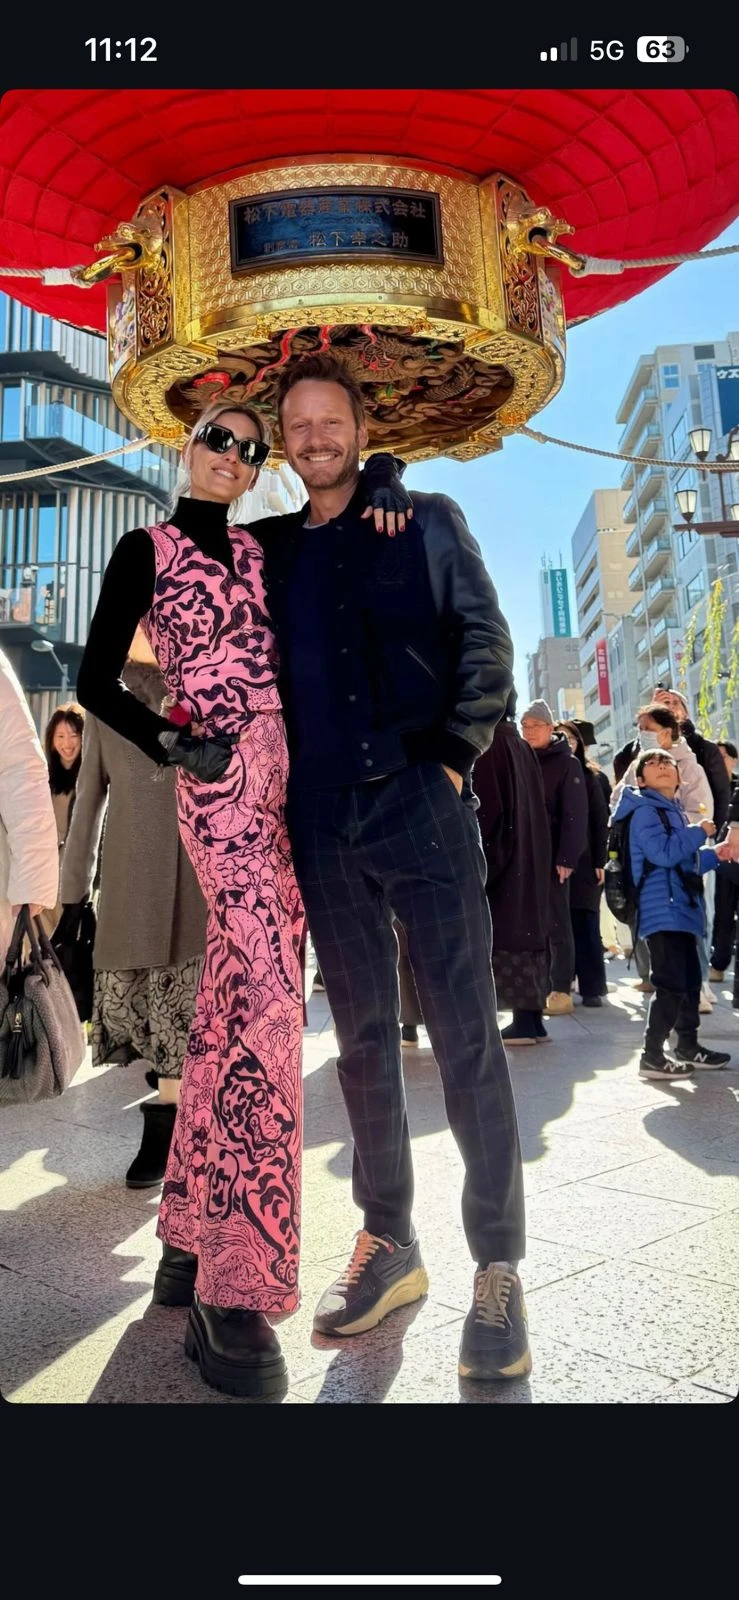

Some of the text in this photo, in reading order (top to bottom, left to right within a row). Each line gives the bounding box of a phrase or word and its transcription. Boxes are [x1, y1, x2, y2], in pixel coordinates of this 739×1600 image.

[308, 229, 409, 248] 松下幸之助
